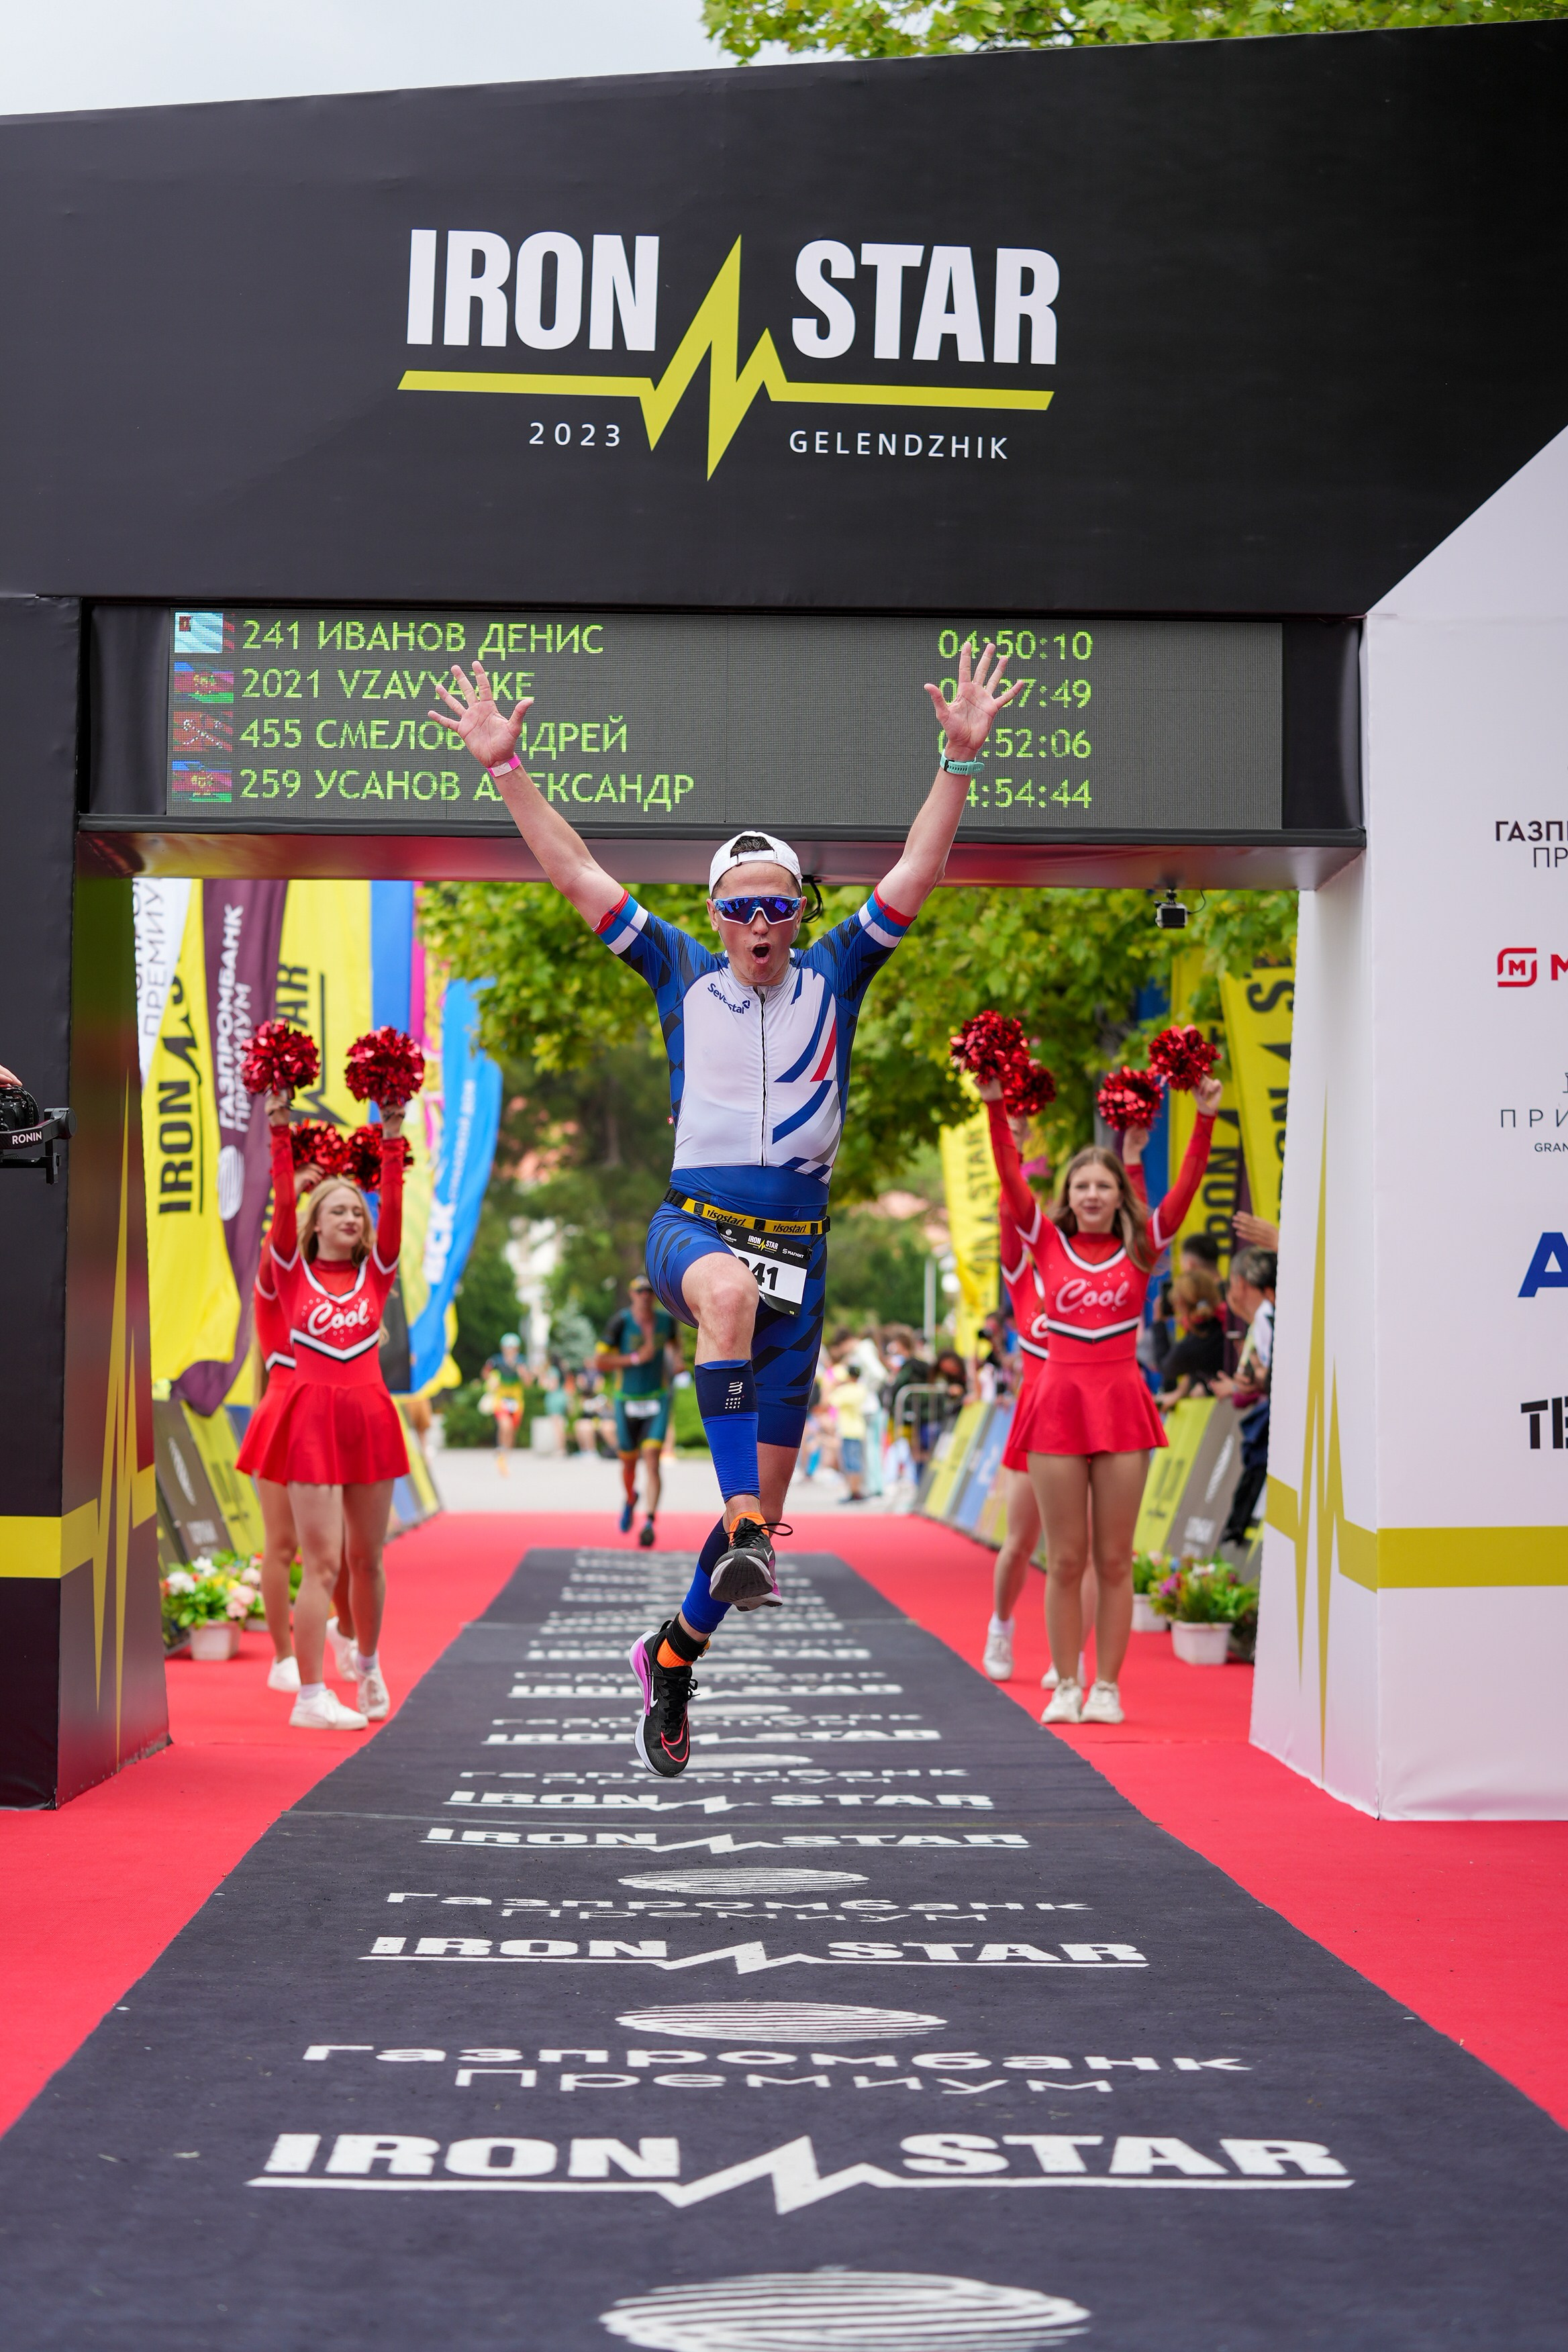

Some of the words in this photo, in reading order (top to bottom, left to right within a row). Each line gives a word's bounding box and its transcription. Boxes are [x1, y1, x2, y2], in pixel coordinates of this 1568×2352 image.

[406, 229, 660, 351] IRON
[792, 240, 1060, 365] STAR
[529, 422, 622, 448] 2023
[789, 430, 1008, 460] GELENDZHIK
[243, 620, 299, 648] 241
[318, 622, 464, 651] ИВАНОВ
[478, 623, 604, 660] ДЕНИС
[243, 669, 320, 697] 2021
[940, 678, 1092, 707] 037:49
[240, 720, 301, 748] 455
[519, 716, 628, 761] ДРЕЙ
[938, 728, 1091, 758] :52:06
[240, 770, 301, 799] 259
[315, 771, 462, 801] УСАНОВ
[473, 773, 695, 812] АКСАНДР
[967, 778, 1092, 808] 4:54:44
[1496, 820, 1568, 842] ГАЗП
[144, 878, 165, 1036] ПРЕМИУ
[215, 903, 244, 1130] ГАЗПРОМБАНК
[12, 1131, 42, 1145] RONIN
[158, 1080, 193, 1215] IRON
[748, 1235, 761, 1244] IRON
[766, 1240, 779, 1250] STAR
[1056, 1278, 1130, 1314] Cool
[307, 1301, 371, 1336] Cool
[450, 1791, 658, 1804] IRON
[771, 1794, 994, 1809] STAR
[426, 1828, 657, 1845] IRON
[782, 1833, 1029, 1846] STAR
[387, 1892, 1094, 1910] Газпромбанк
[501, 1908, 987, 1922] Премиум
[371, 1937, 667, 1957] IRON
[828, 1941, 1148, 1962] STAR
[303, 2045, 1254, 2071] Газпромбанк
[454, 2069, 1114, 2095] Премиум
[264, 2134, 681, 2179] IRON
[899, 2133, 1350, 2177] STAR
